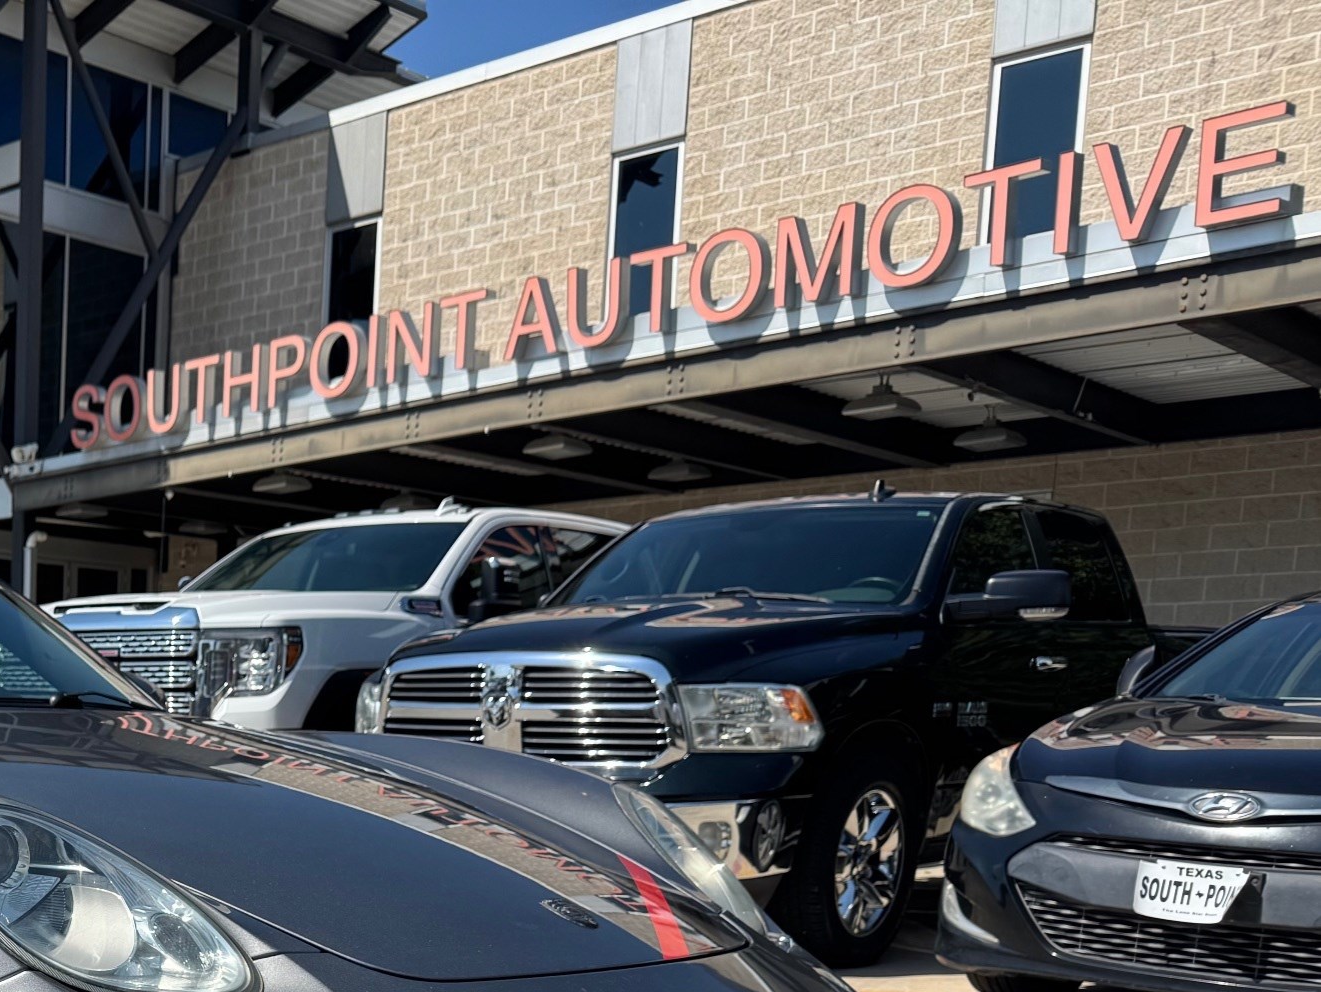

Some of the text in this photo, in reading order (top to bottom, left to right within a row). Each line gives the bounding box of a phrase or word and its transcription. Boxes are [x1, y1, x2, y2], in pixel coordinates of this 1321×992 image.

[71, 101, 1292, 450] SOUTHPOINT AUTOMOTIVE
[1177, 866, 1223, 880] TEXAS
[1140, 876, 1194, 906] SOUTH
